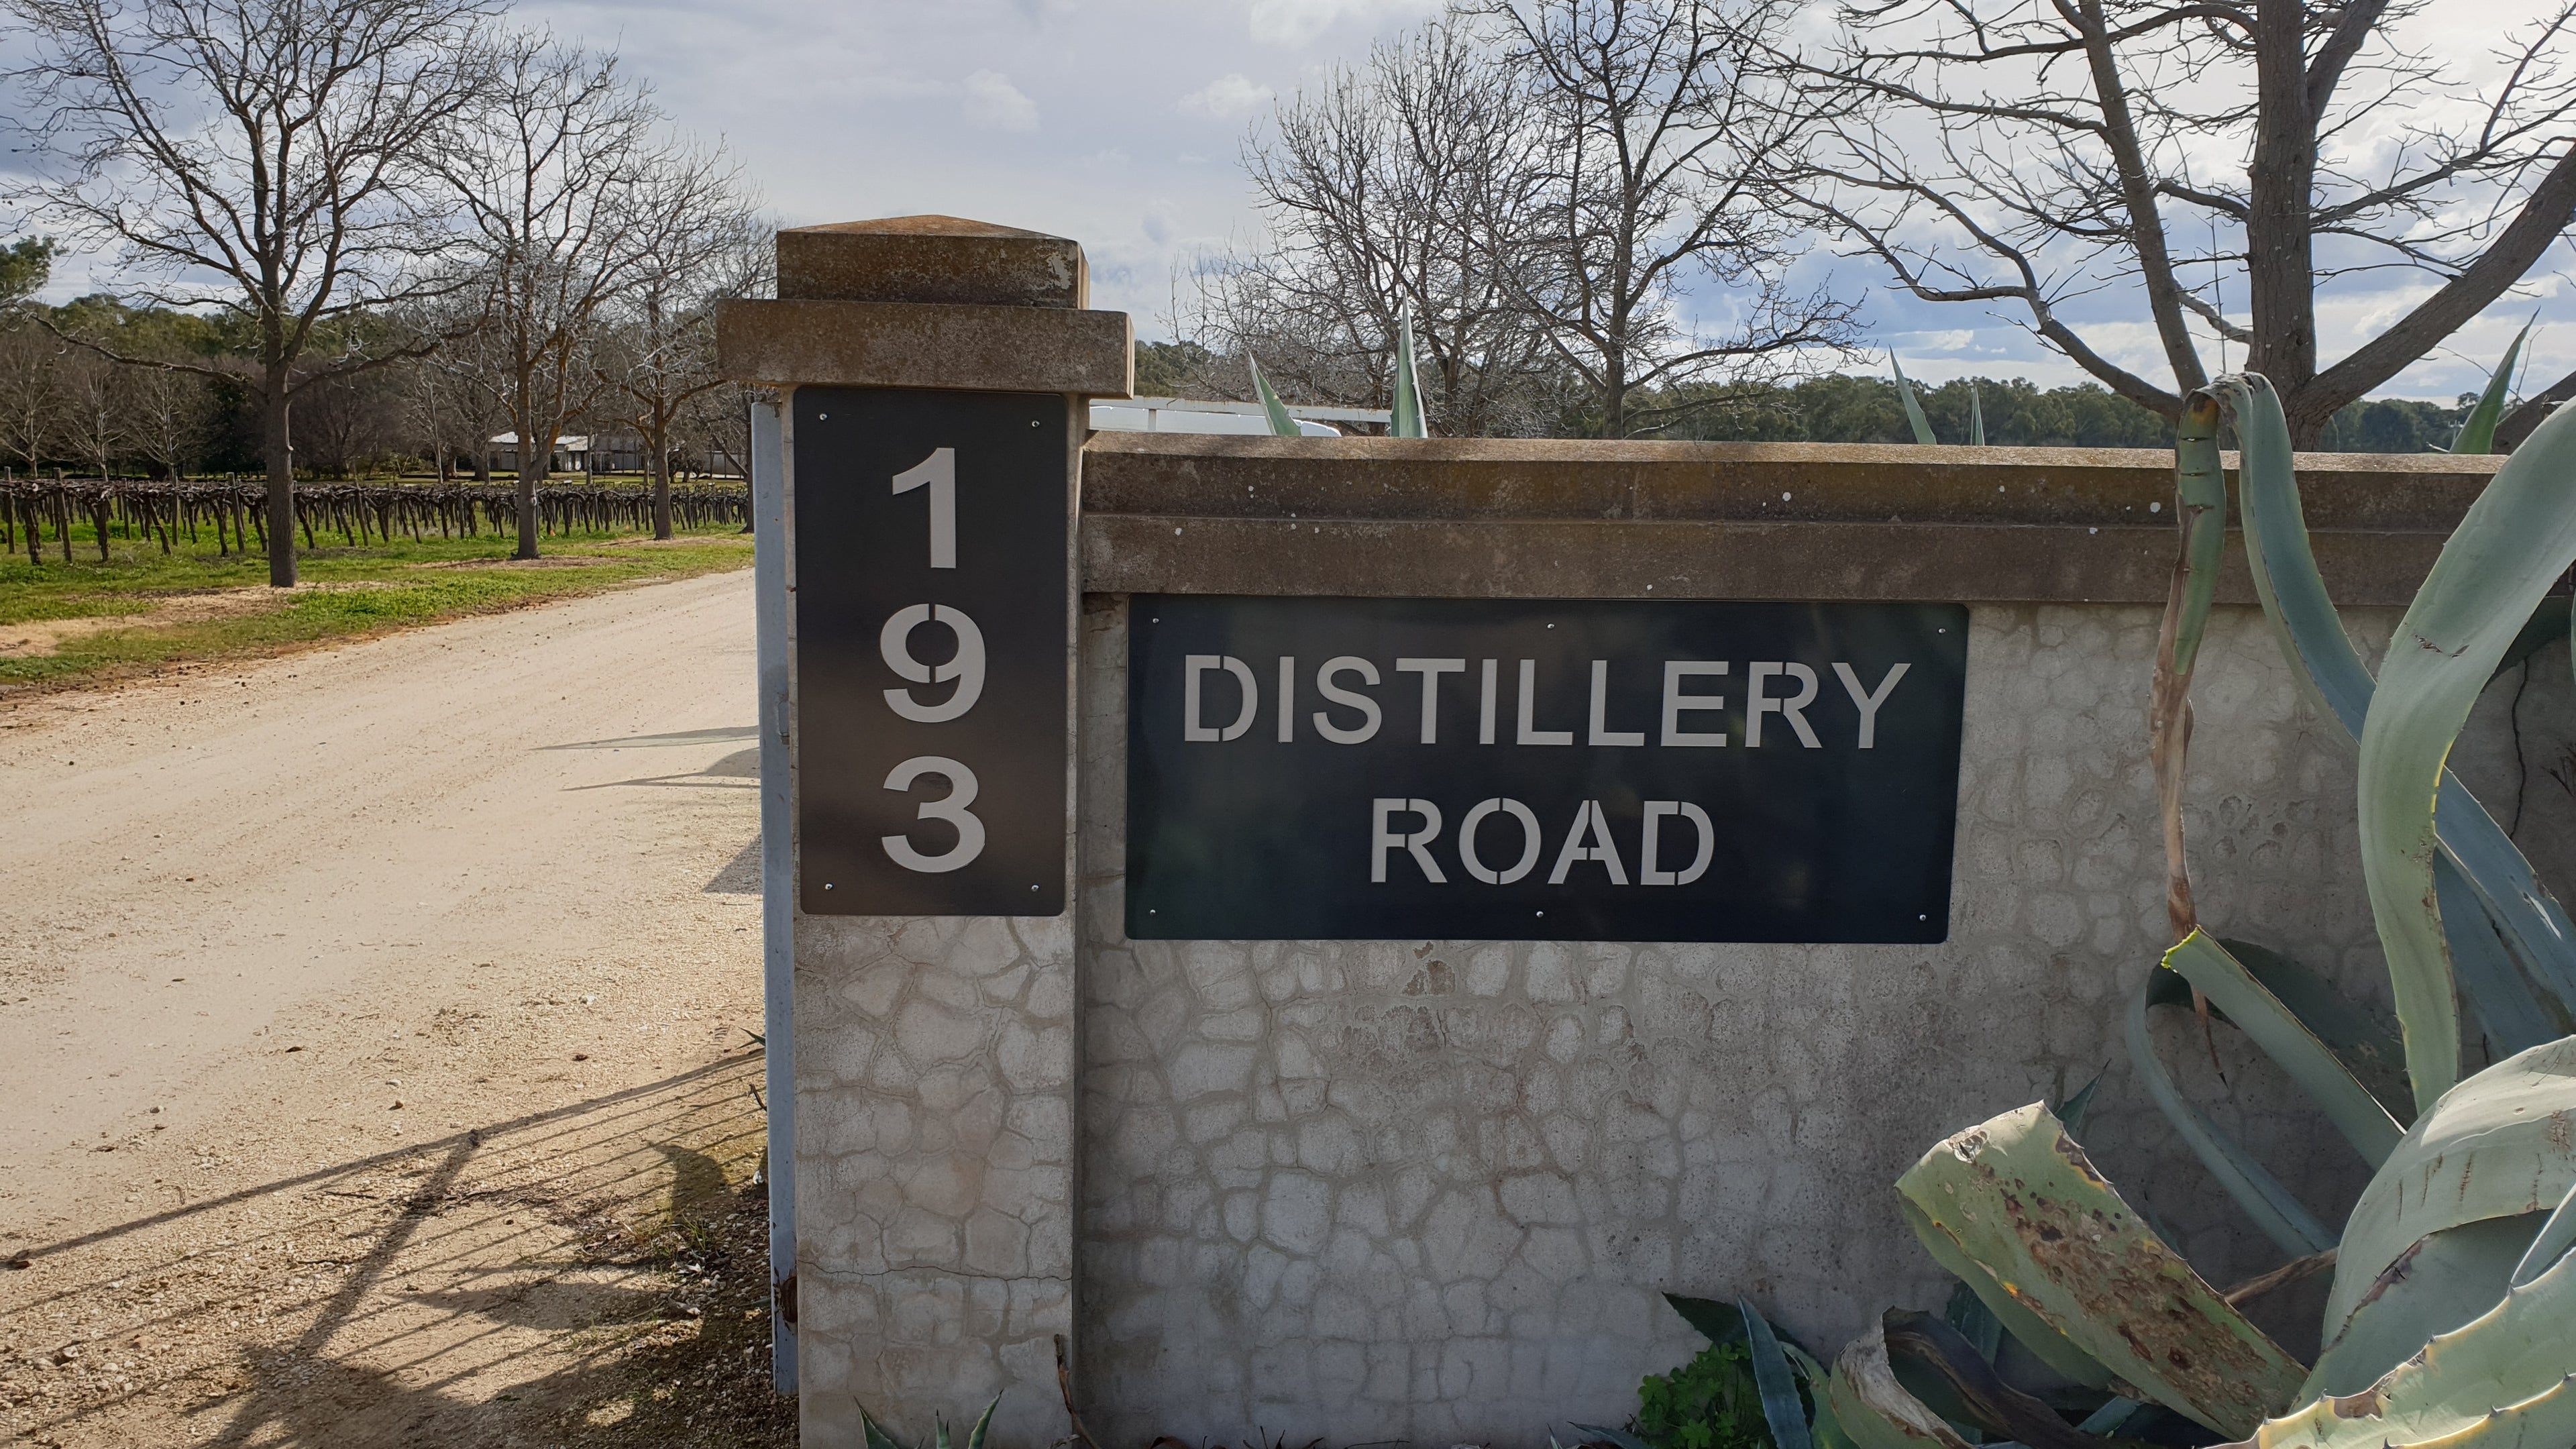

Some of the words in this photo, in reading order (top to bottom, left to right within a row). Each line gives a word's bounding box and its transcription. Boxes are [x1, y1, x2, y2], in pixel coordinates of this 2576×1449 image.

[880, 447, 986, 873] 193
[1185, 655, 1911, 749] DISTILLERY
[1371, 798, 1714, 885] ROAD
